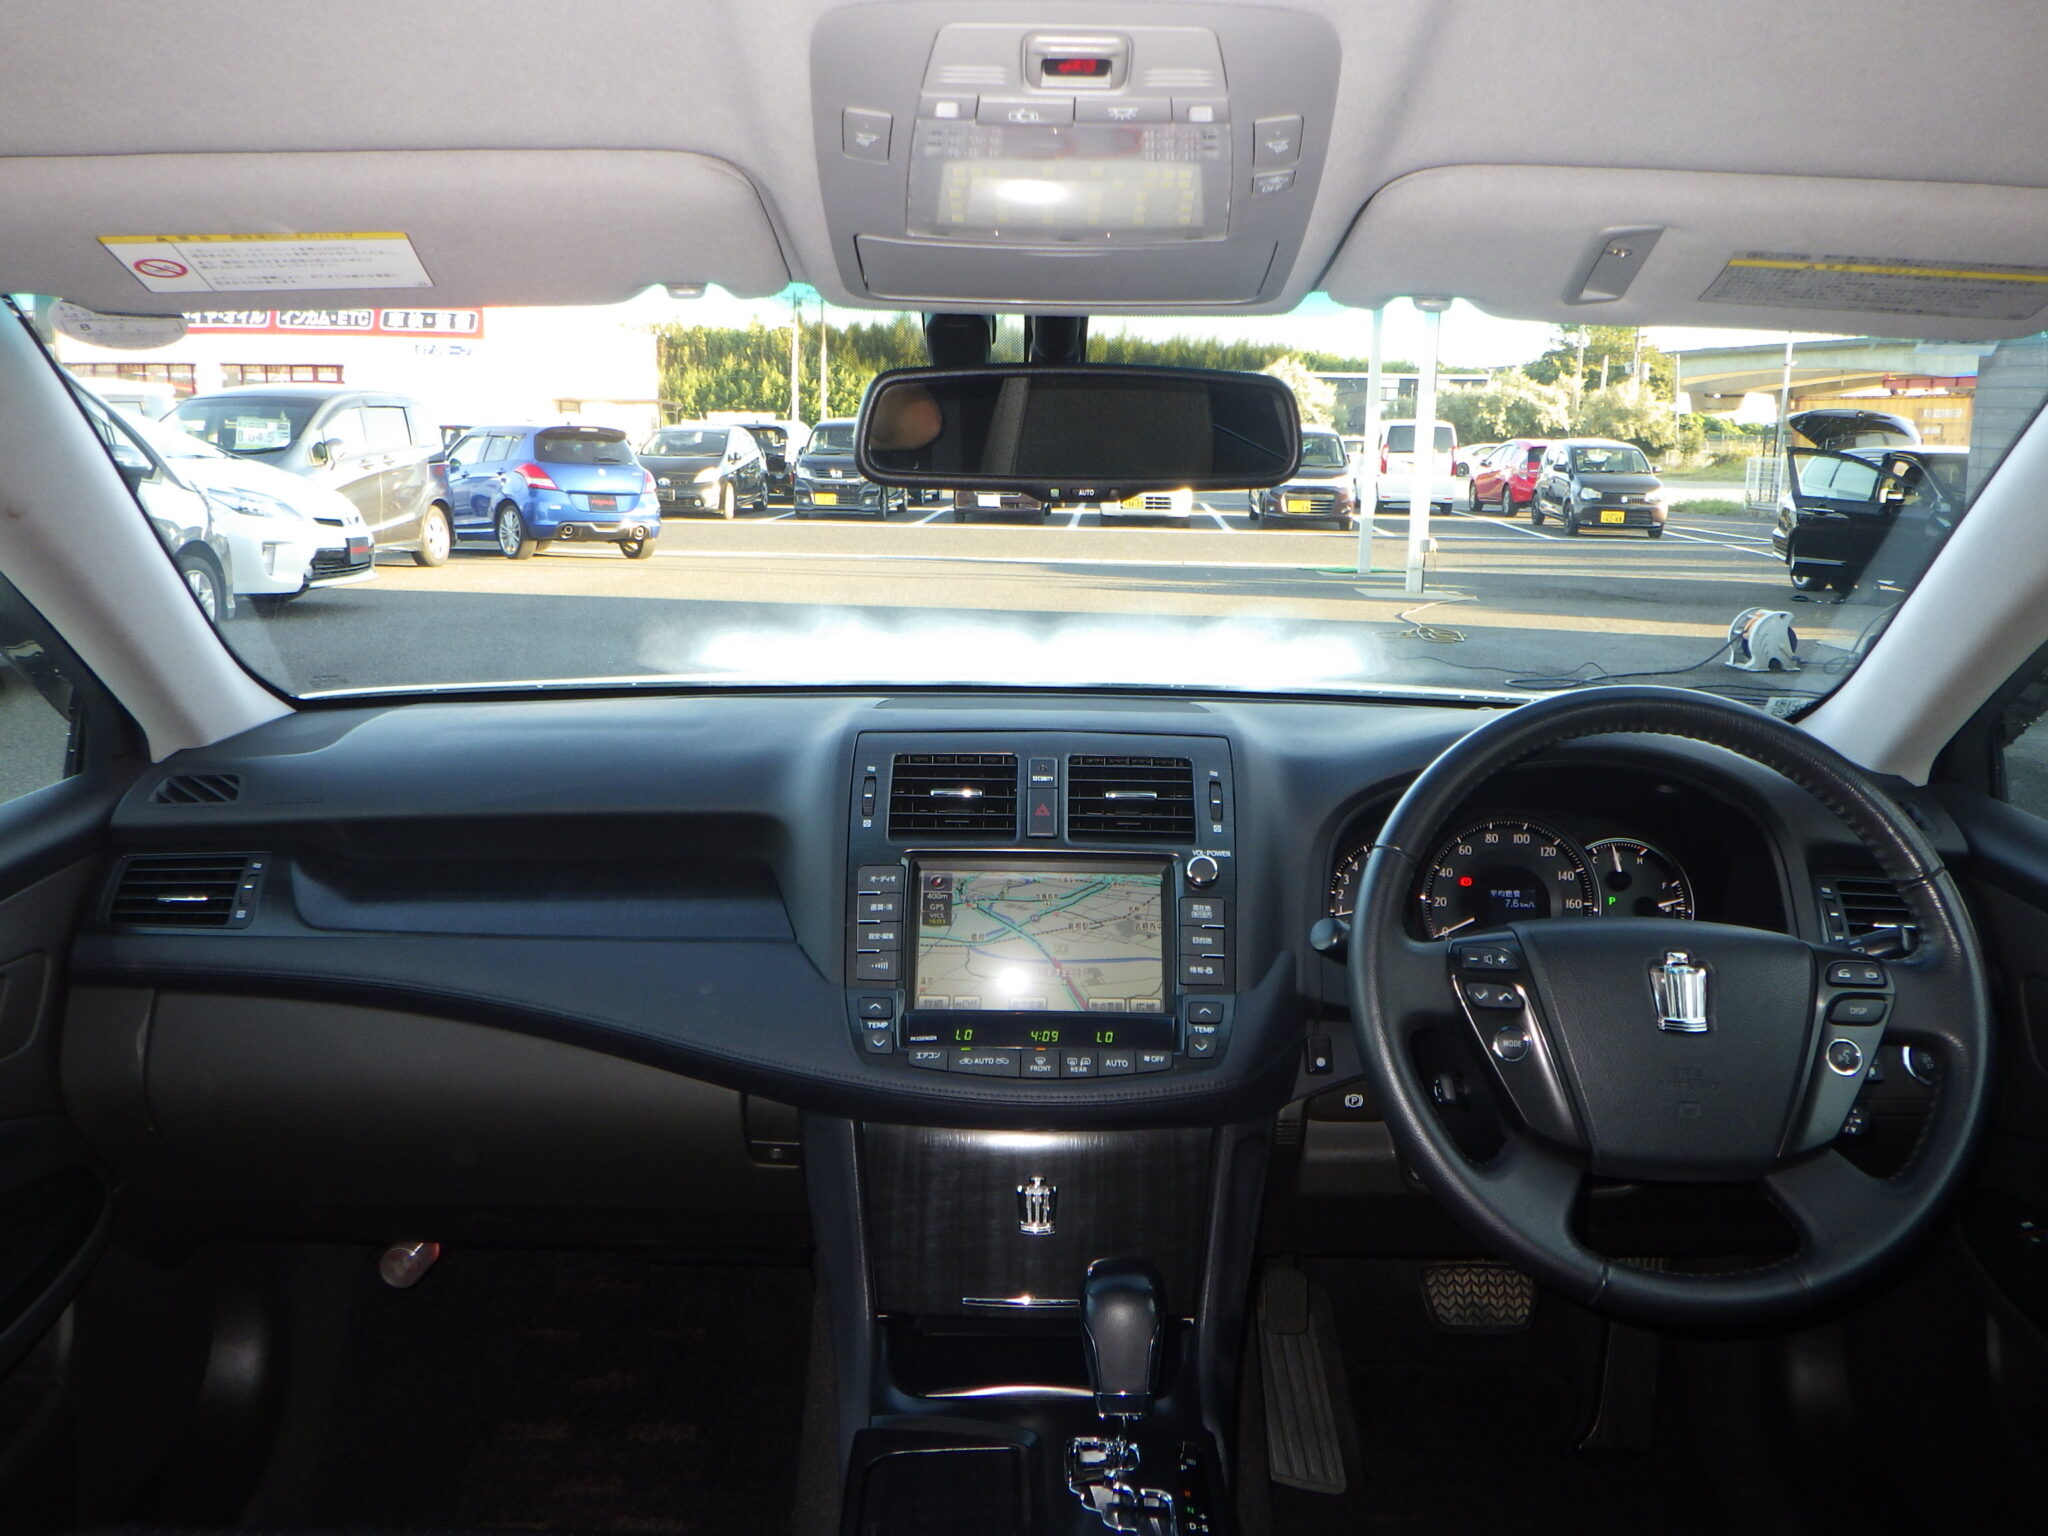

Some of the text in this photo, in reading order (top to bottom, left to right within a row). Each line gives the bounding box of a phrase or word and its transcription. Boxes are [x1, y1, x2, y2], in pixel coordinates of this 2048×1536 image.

[1485, 834, 1499, 844] 80
[1513, 834, 1531, 844] 100
[1458, 845, 1472, 855] 60
[1541, 847, 1557, 857] 120
[1636, 857, 1643, 865] H
[1352, 862, 1359, 871] 4
[1439, 868, 1453, 877] 40
[1558, 871, 1575, 881] 140
[1343, 874, 1350, 885] 3
[1338, 889, 1344, 899] 2
[1434, 897, 1448, 907] 20
[1505, 899, 1519, 908] 7.6
[1566, 899, 1582, 909] 160
[1609, 897, 1616, 905] P
[929, 903, 945, 911] GPS
[1030, 1031, 1059, 1042] 4:09
[1106, 1059, 1128, 1067] AUTO
